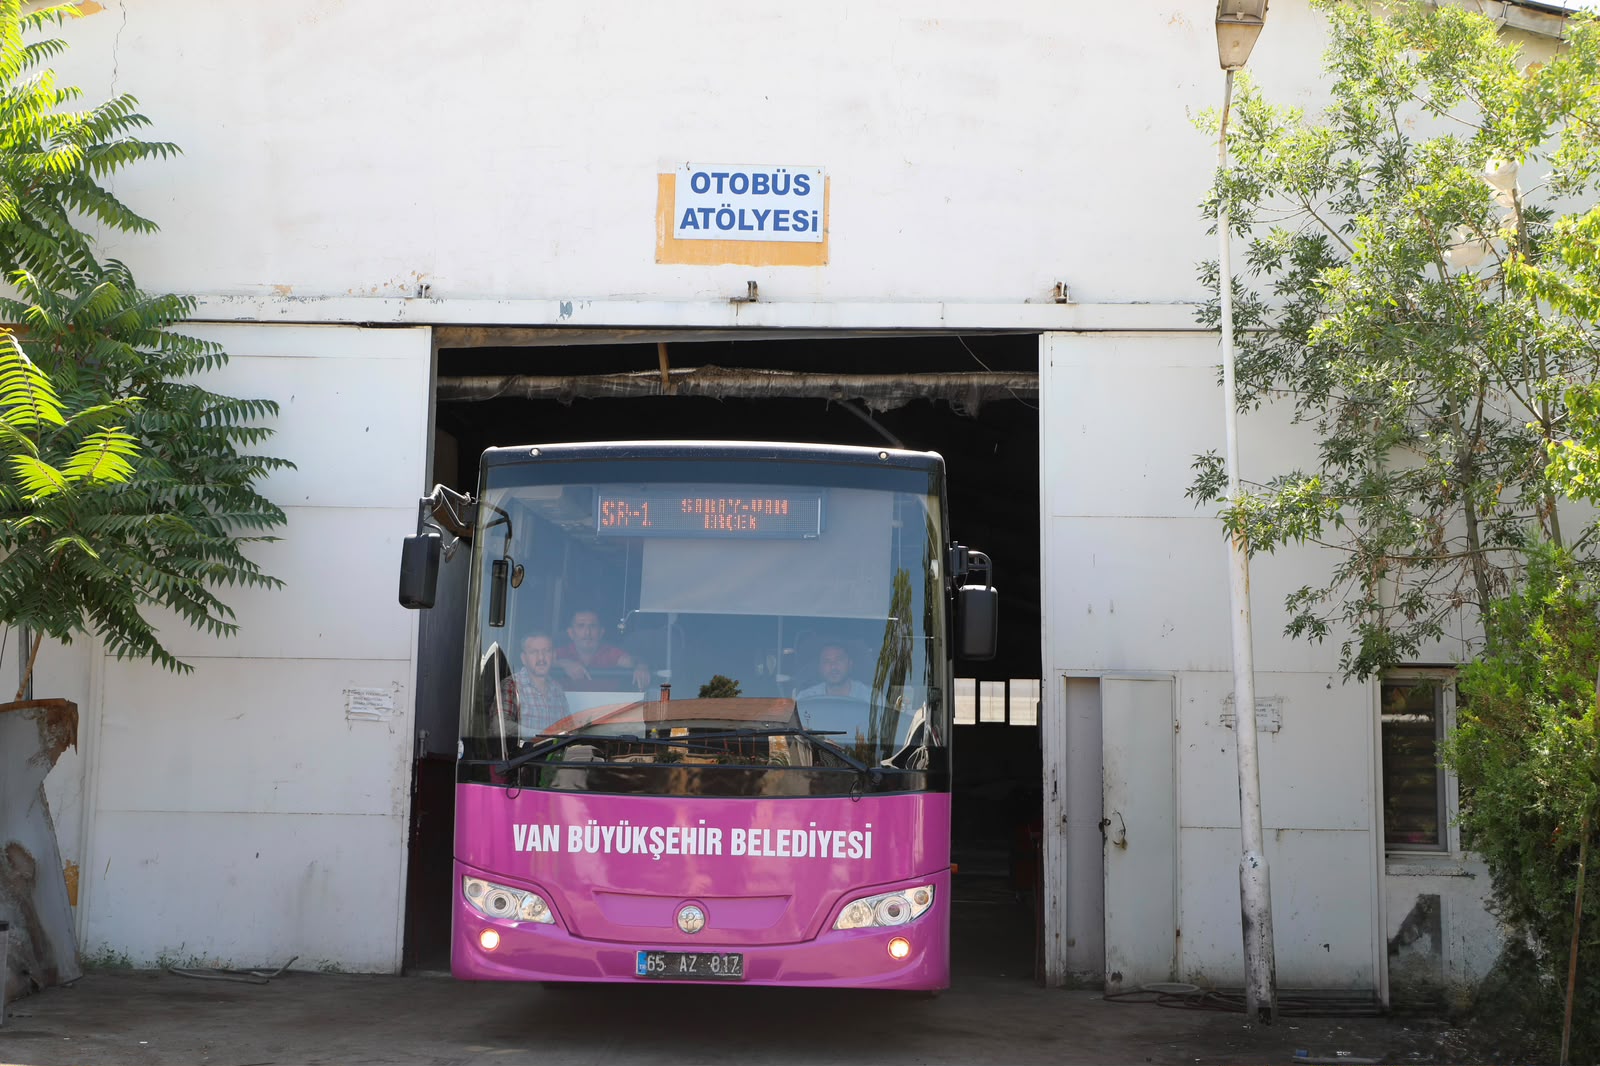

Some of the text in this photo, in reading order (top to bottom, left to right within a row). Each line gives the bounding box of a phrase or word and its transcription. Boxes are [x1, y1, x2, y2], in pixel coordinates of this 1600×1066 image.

[691, 169, 811, 197] OTOBÜS
[512, 819, 873, 861] VAN BÜYÜKŞEHİR BELEDİYESİ
[647, 954, 740, 973] 65 AZ 817
